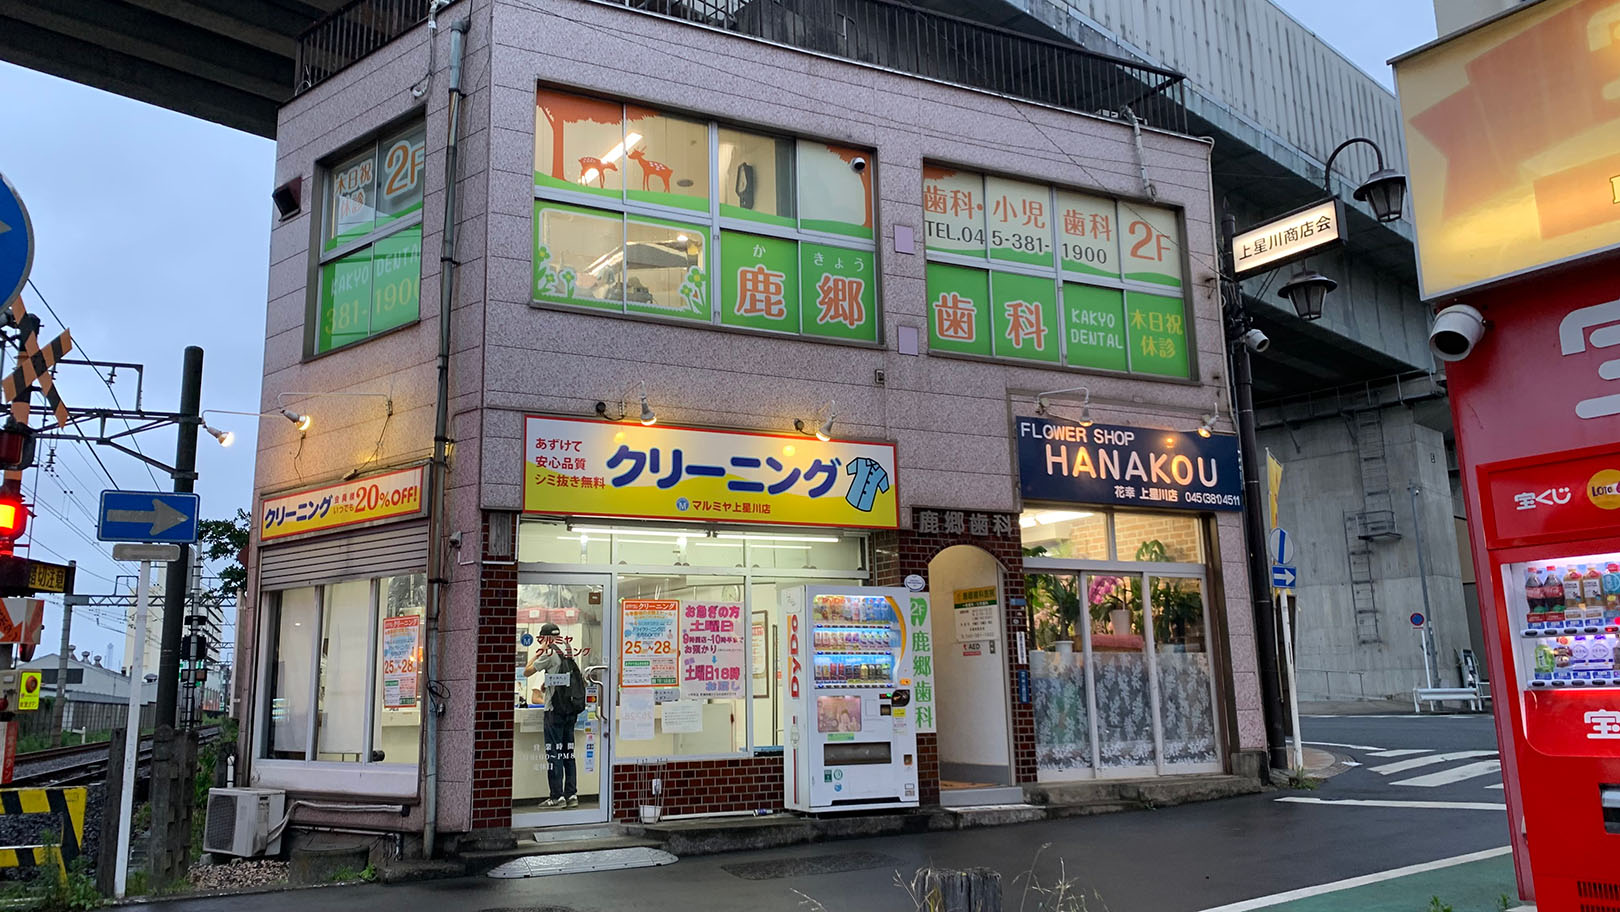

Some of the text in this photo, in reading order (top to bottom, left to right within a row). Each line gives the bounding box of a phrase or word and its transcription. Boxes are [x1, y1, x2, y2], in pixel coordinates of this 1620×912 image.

[1129, 219, 1171, 262] 2F
[1238, 215, 1331, 261] 上星川商店会
[753, 244, 865, 272] か きょう
[1071, 308, 1115, 327] KAKYO
[1130, 309, 1184, 336] 木日祝
[1070, 331, 1123, 350] DENTAL
[1139, 335, 1177, 359] 休診
[535, 437, 583, 453] あずけて
[1020, 422, 1136, 446] FLOWER SHOP
[535, 455, 587, 471] 安心品質
[605, 444, 843, 499] クリーニング
[1045, 443, 1218, 488] HANAKOU
[535, 473, 606, 490] シミ抜き無料
[1138, 487, 1179, 503] 上星川店
[1514, 487, 1572, 511] 宝くじ
[264, 494, 333, 530] クリーニング
[692, 499, 772, 516] マルミヤ上星川店
[918, 509, 1013, 538] 鹿郷歯科
[689, 619, 735, 633] 土曜日
[535, 635, 574, 645] マルミヤ
[535, 647, 592, 657] クリーニング
[911, 630, 933, 729] 鹿郷歯科
